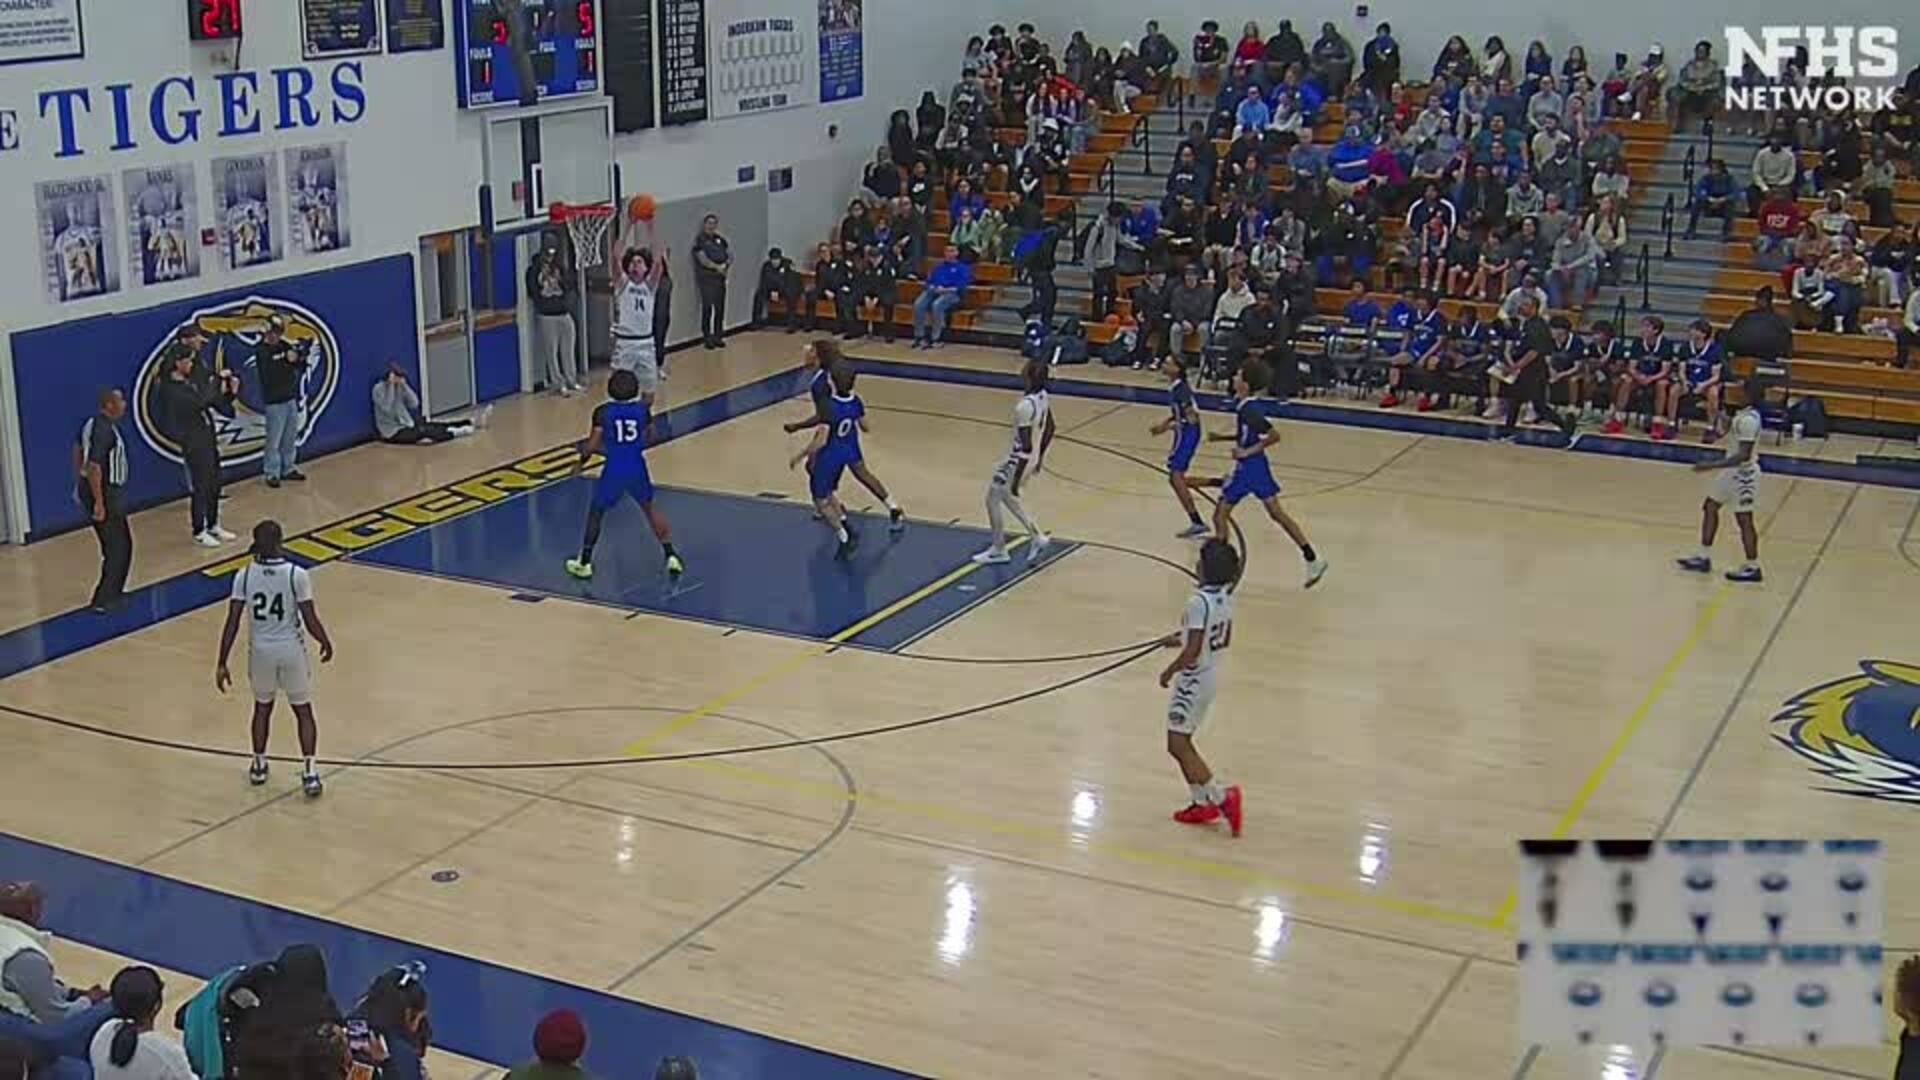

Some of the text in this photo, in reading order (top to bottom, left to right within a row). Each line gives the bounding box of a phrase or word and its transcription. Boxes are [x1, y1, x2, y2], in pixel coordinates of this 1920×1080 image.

[578, 2, 593, 34] 5
[38, 61, 366, 158] TIGERS
[615, 419, 638, 443] 13
[837, 418, 852, 437] 0
[252, 592, 284, 621] 24
